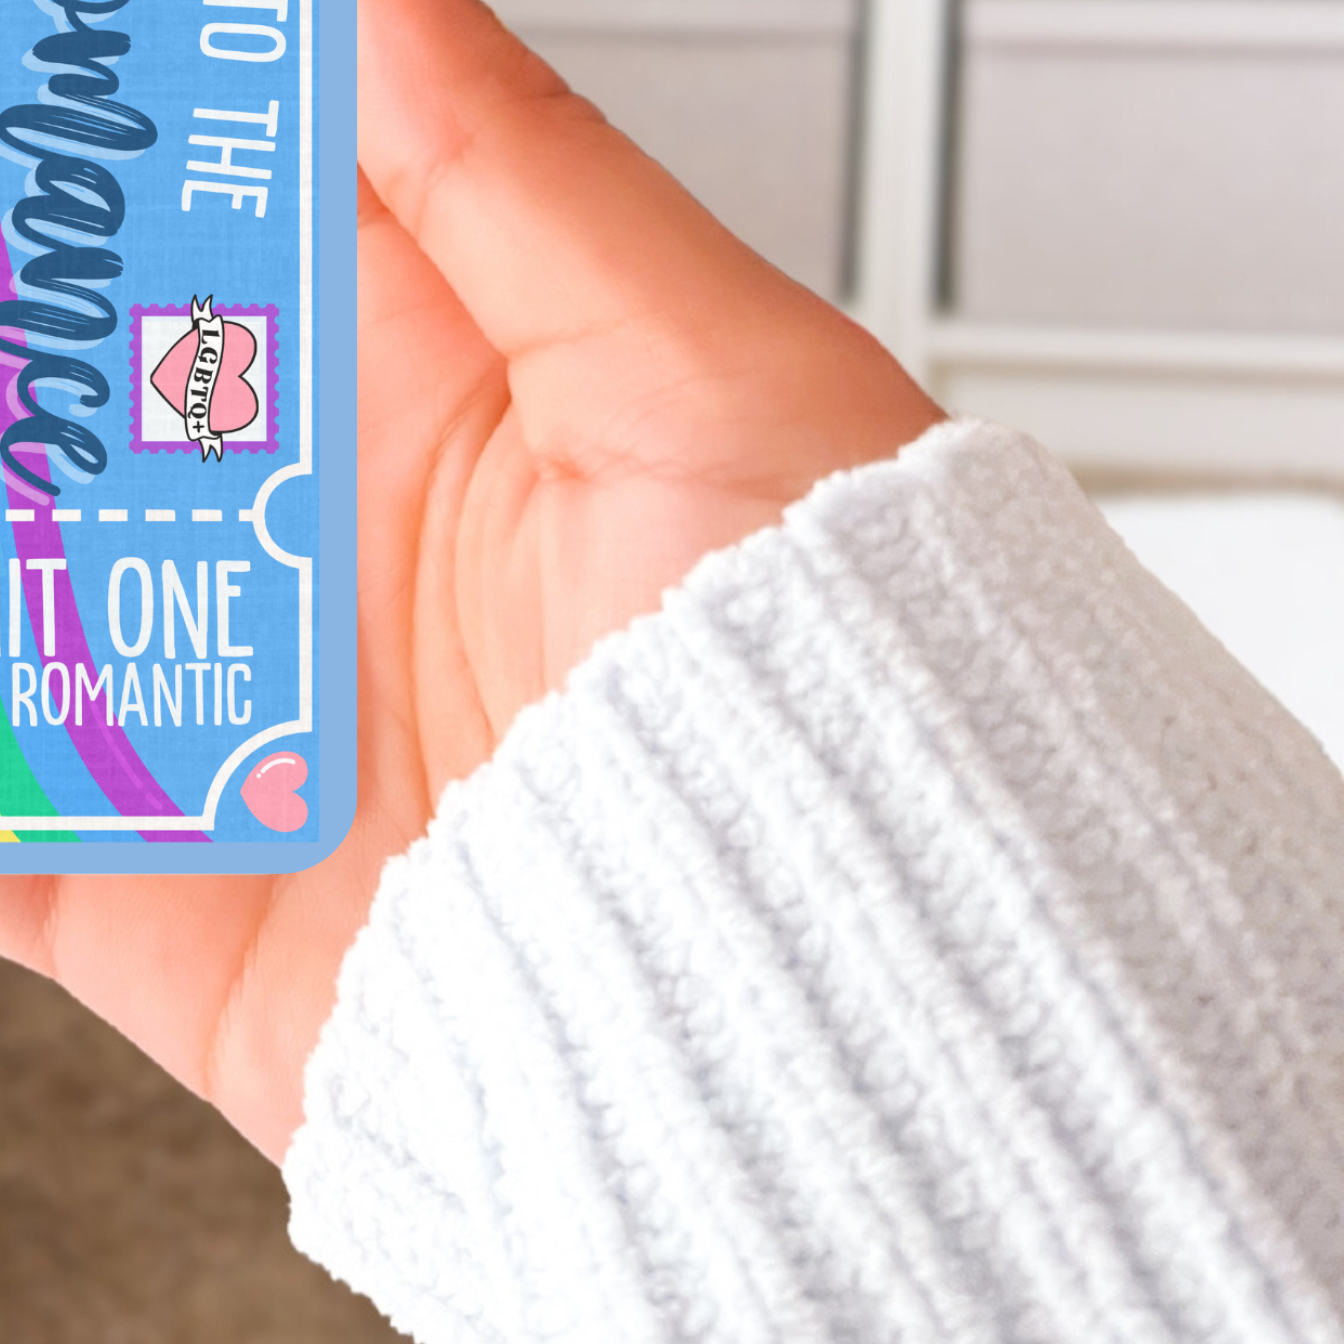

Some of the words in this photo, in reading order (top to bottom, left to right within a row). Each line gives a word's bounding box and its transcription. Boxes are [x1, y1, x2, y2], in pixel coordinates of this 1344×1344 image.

[181, 99, 280, 218] THE
[187, 329, 221, 434] LGBTQ+
[107, 556, 254, 659] ONE
[11, 661, 253, 727] ROMANTIC
